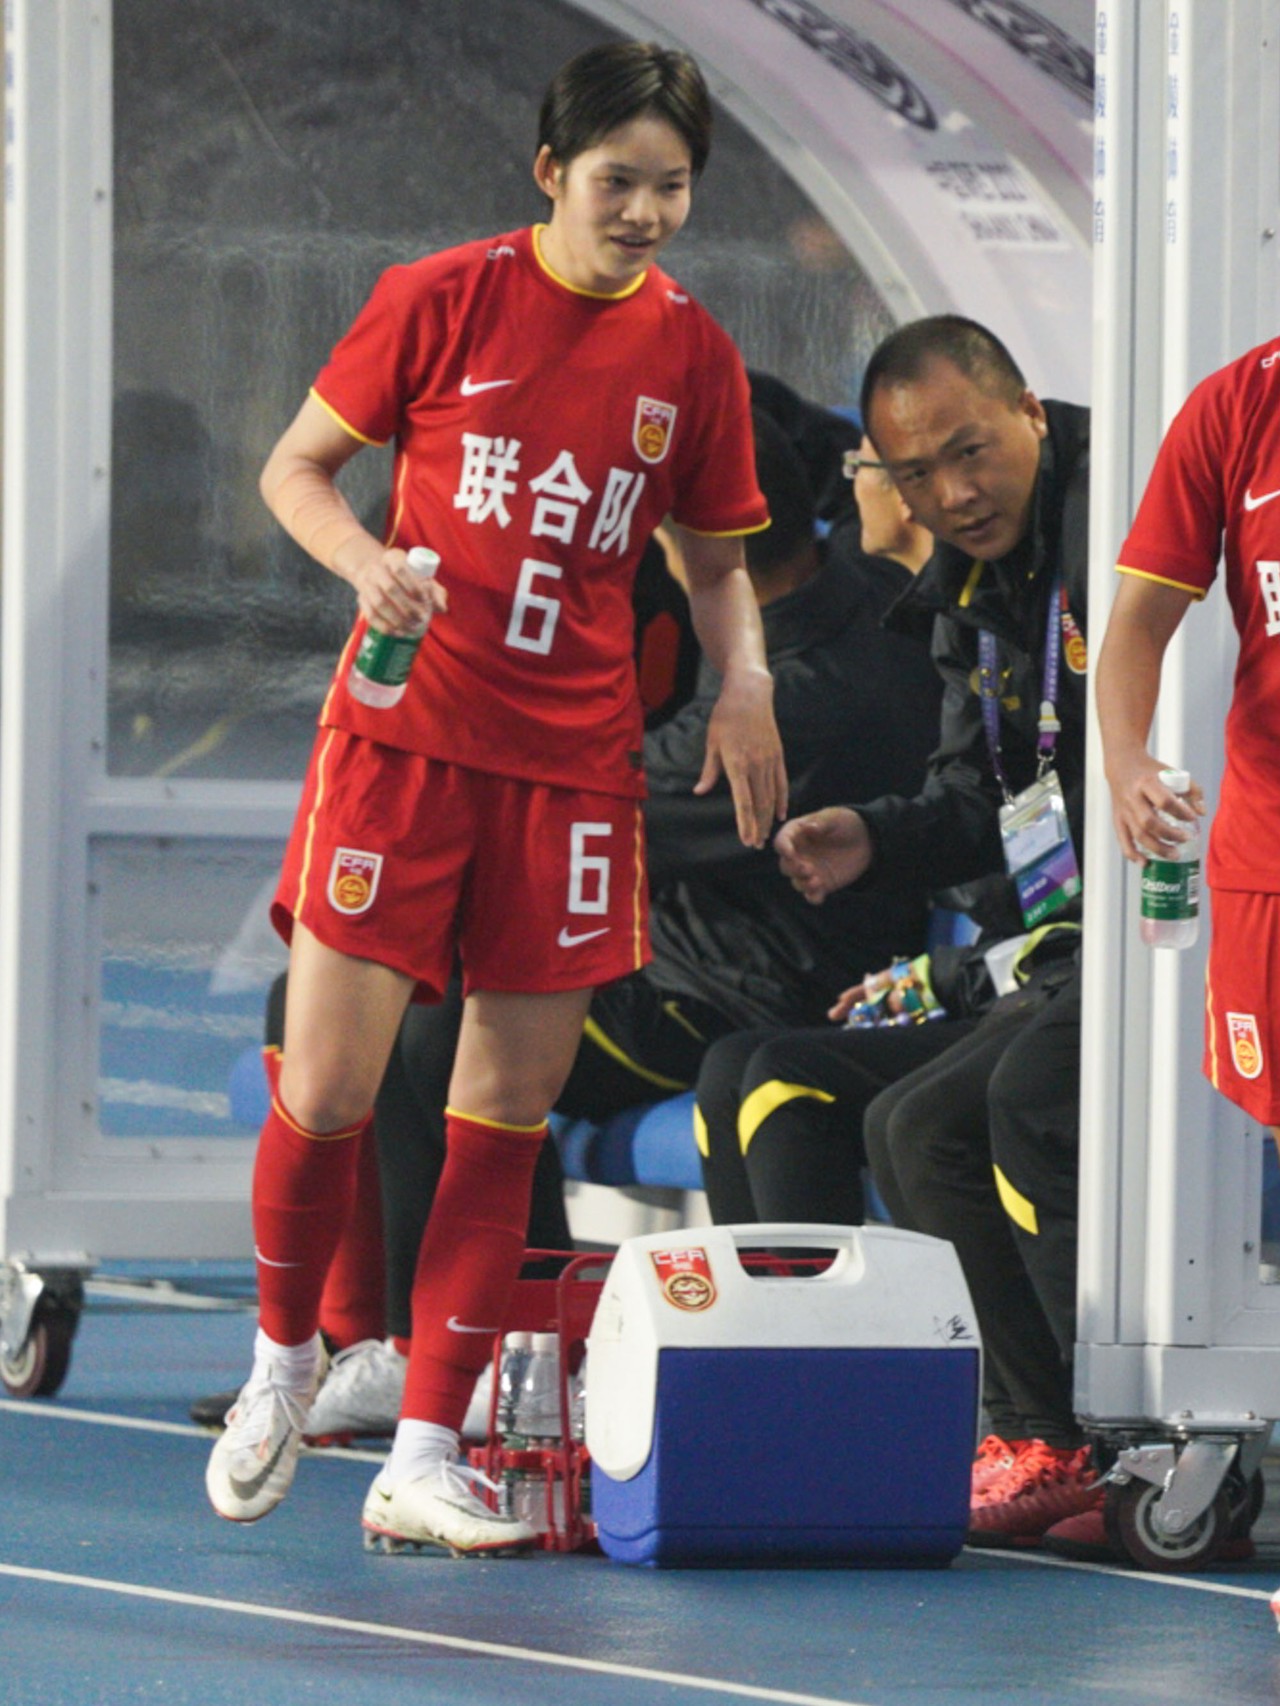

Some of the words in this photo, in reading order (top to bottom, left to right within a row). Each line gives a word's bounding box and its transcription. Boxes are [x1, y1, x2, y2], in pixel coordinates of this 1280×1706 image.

[453, 432, 646, 557] 联合队
[504, 558, 563, 656] 6
[567, 822, 612, 915] 6
[654, 1249, 706, 1265] CFA
